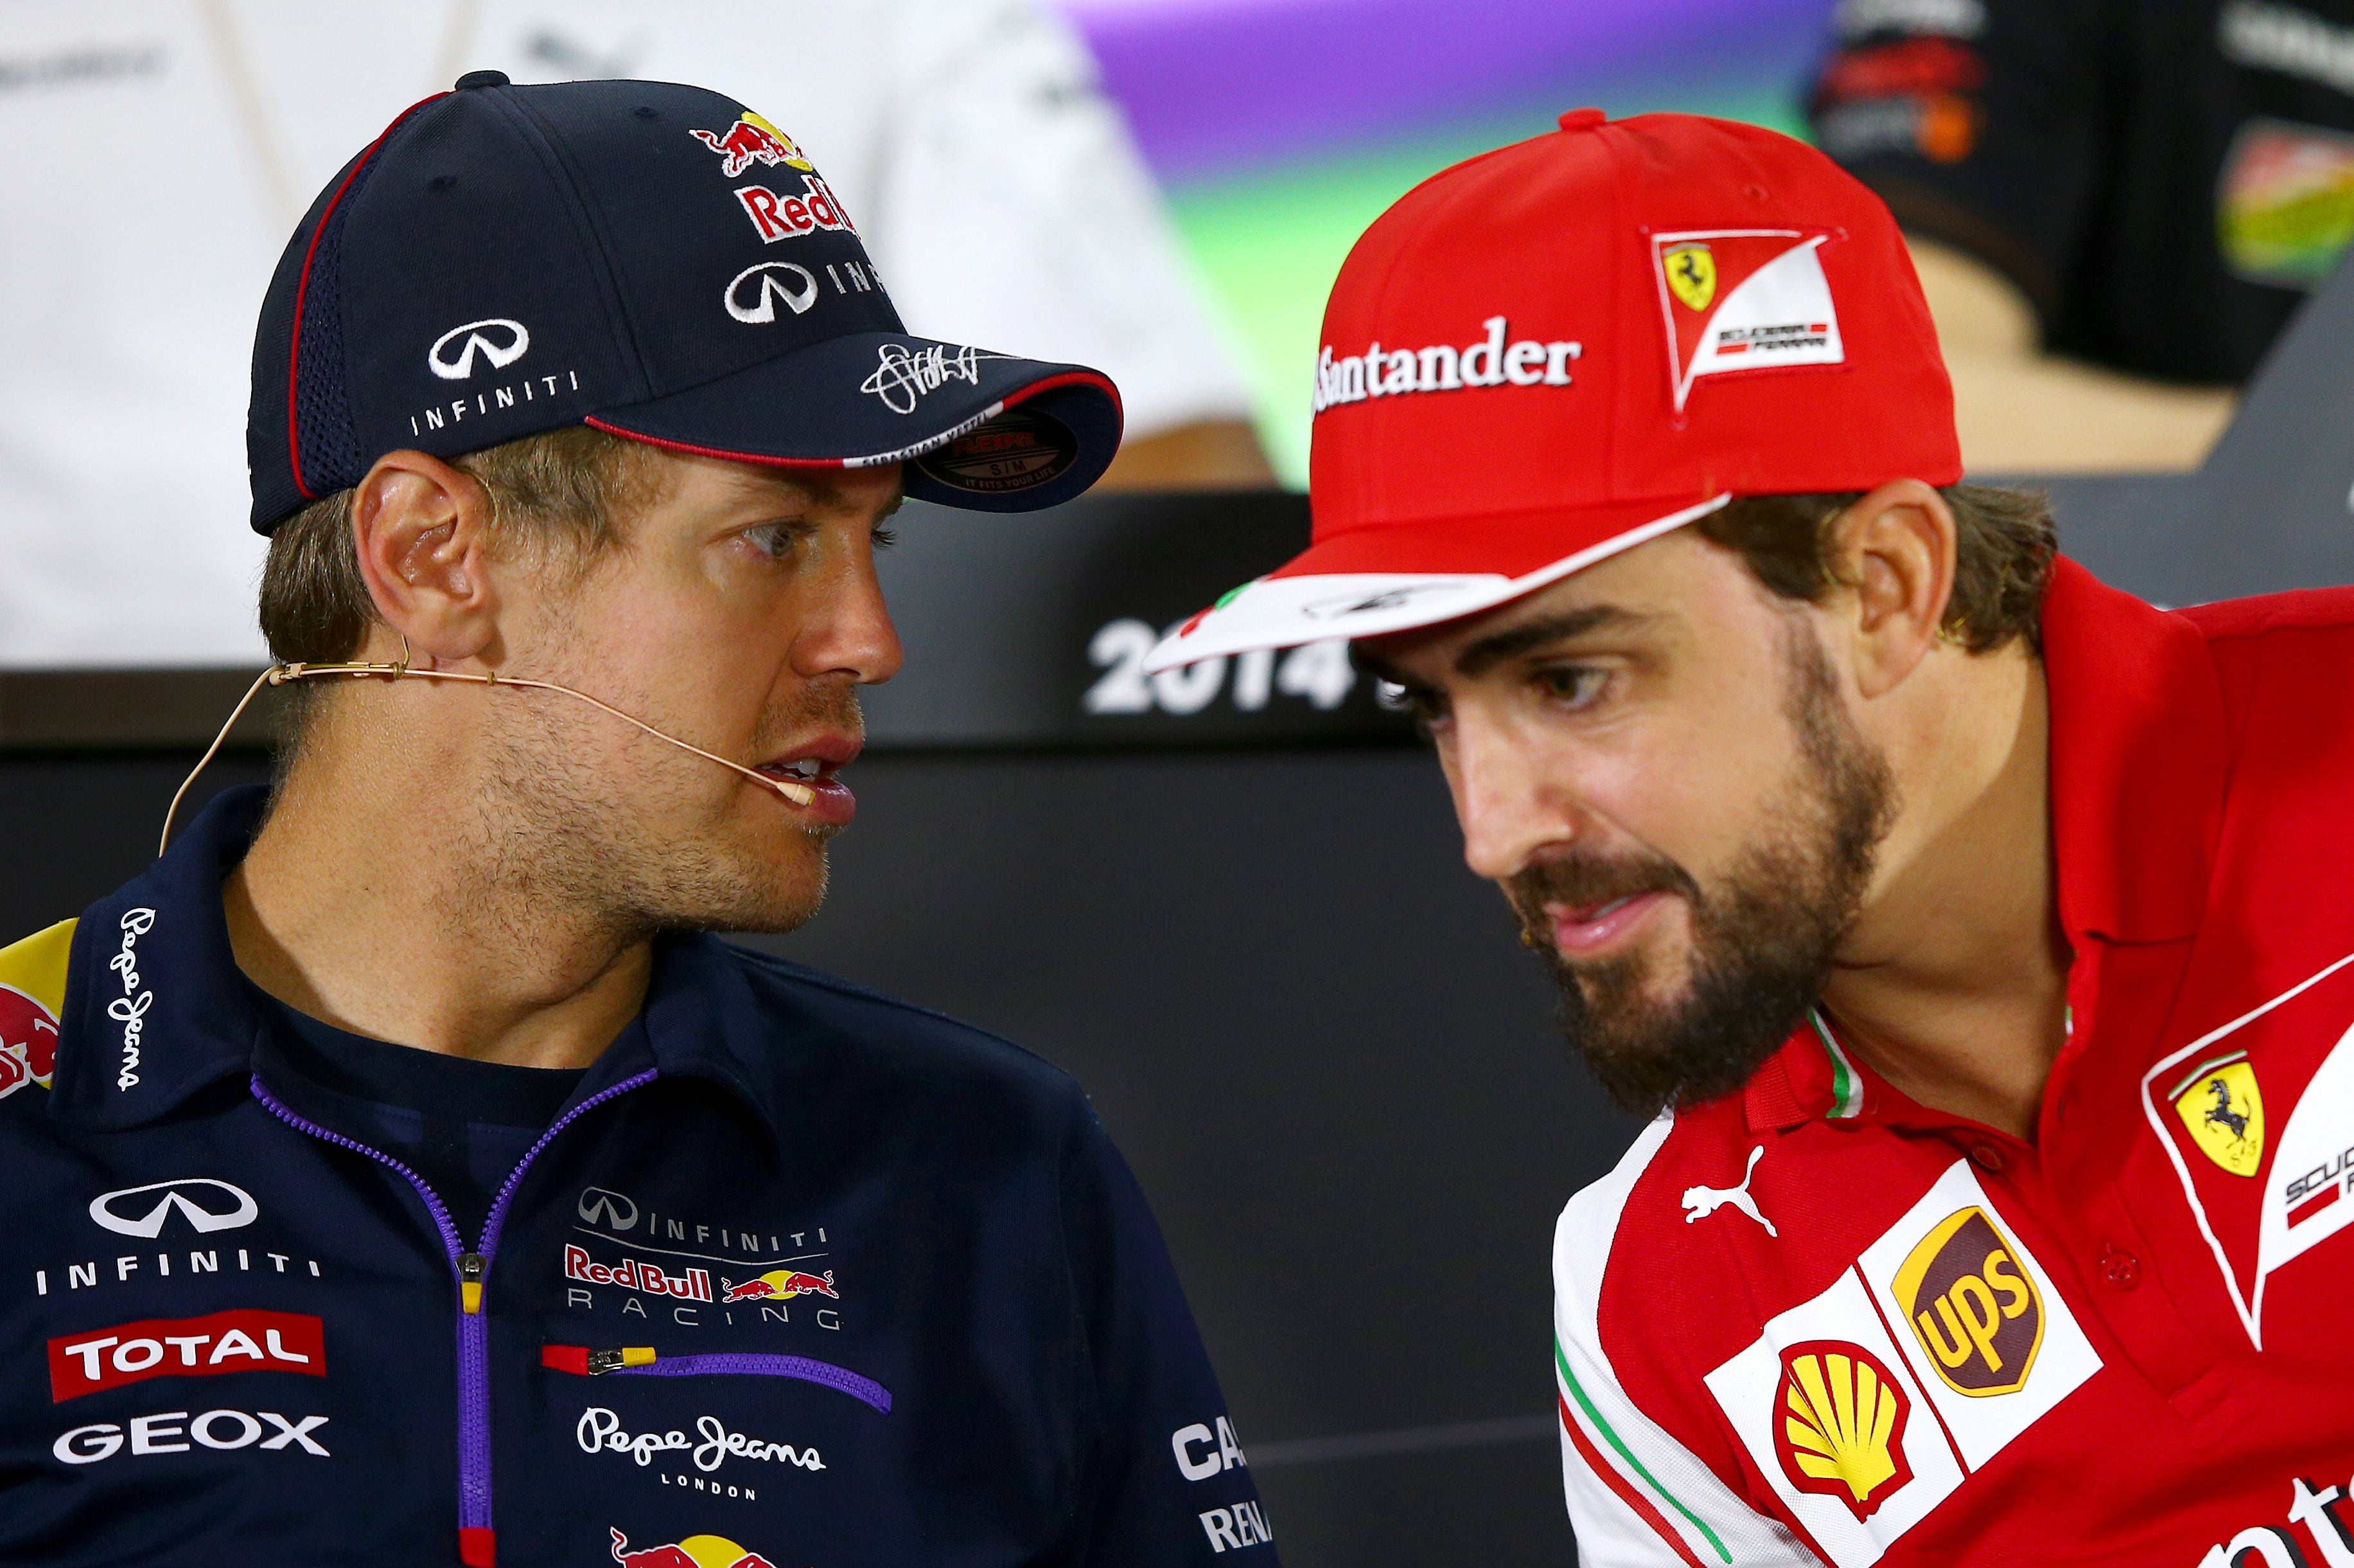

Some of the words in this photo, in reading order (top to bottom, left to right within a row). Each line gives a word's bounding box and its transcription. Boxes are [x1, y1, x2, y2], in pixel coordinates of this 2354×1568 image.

[1315, 315, 1582, 412] Santander
[410, 370, 579, 436] INFINITI
[953, 431, 1035, 456] FLEXFIT
[965, 478, 977, 487] IT
[979, 478, 1003, 489] FITS
[1005, 475, 1035, 488] YOUR
[1035, 466, 1056, 481] LIFE
[1083, 618, 1356, 713] 2014
[110, 907, 156, 995] Pepe
[107, 990, 153, 1091] Jeans
[651, 1213, 827, 1251] INFINITI
[37, 1249, 321, 1295] INFINITI
[568, 1288, 841, 1330] RACING
[1917, 1249, 2030, 1373] ups
[65, 1328, 310, 1381] TOTAL
[53, 1409, 331, 1465] GEOX
[577, 1407, 692, 1467] Pepe
[693, 1416, 827, 1472] Jeans
[1172, 1415, 1247, 1481] CA
[661, 1474, 755, 1501] LONDON
[1199, 1500, 1273, 1553] REN
